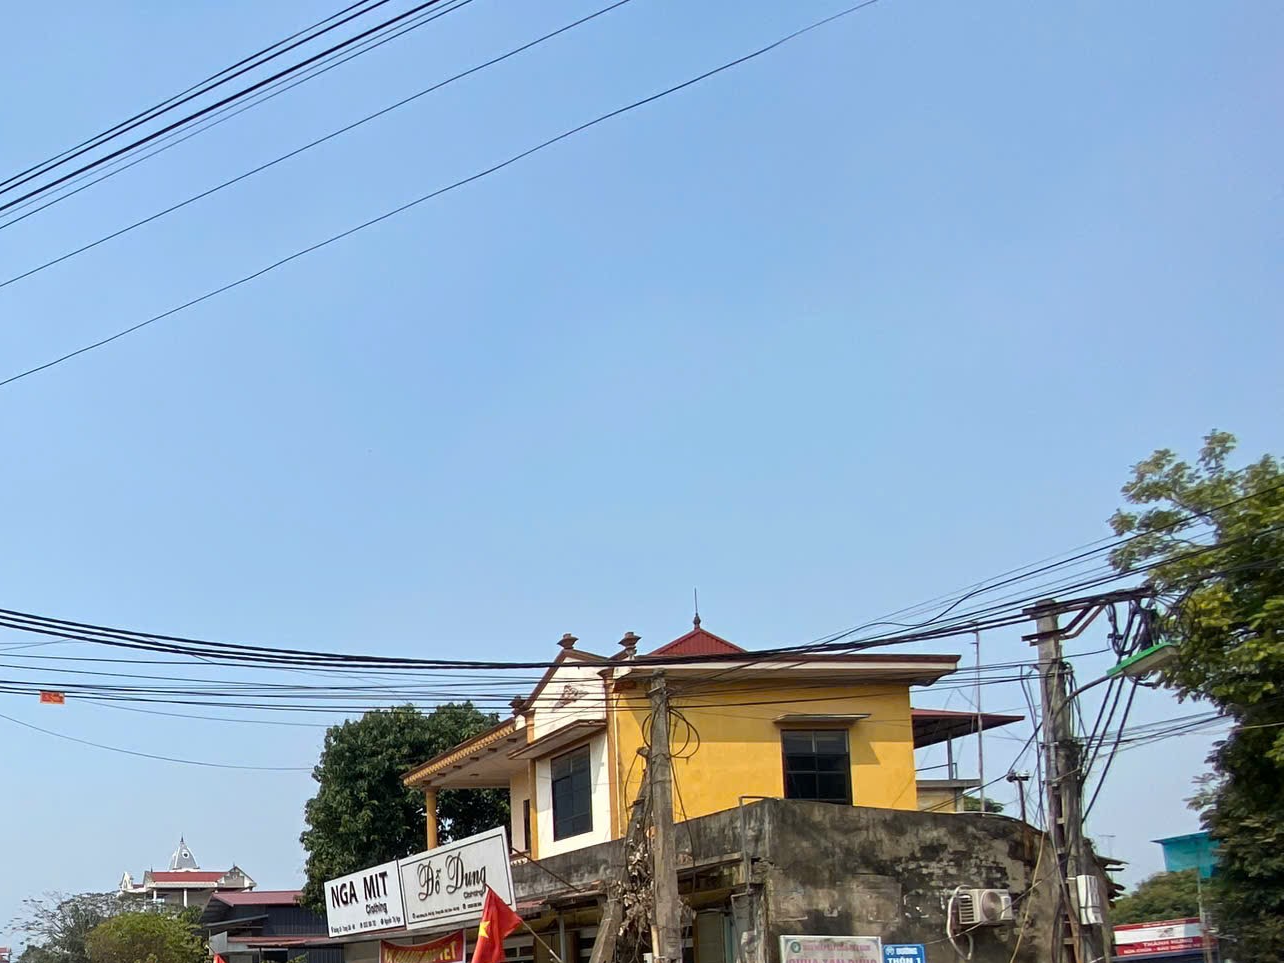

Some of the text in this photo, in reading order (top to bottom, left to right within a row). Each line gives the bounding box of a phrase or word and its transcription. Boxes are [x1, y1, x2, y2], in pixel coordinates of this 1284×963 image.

[331, 871, 389, 909] NGA MIT
[445, 851, 486, 894] Dung
[366, 901, 388, 916] Clothing
